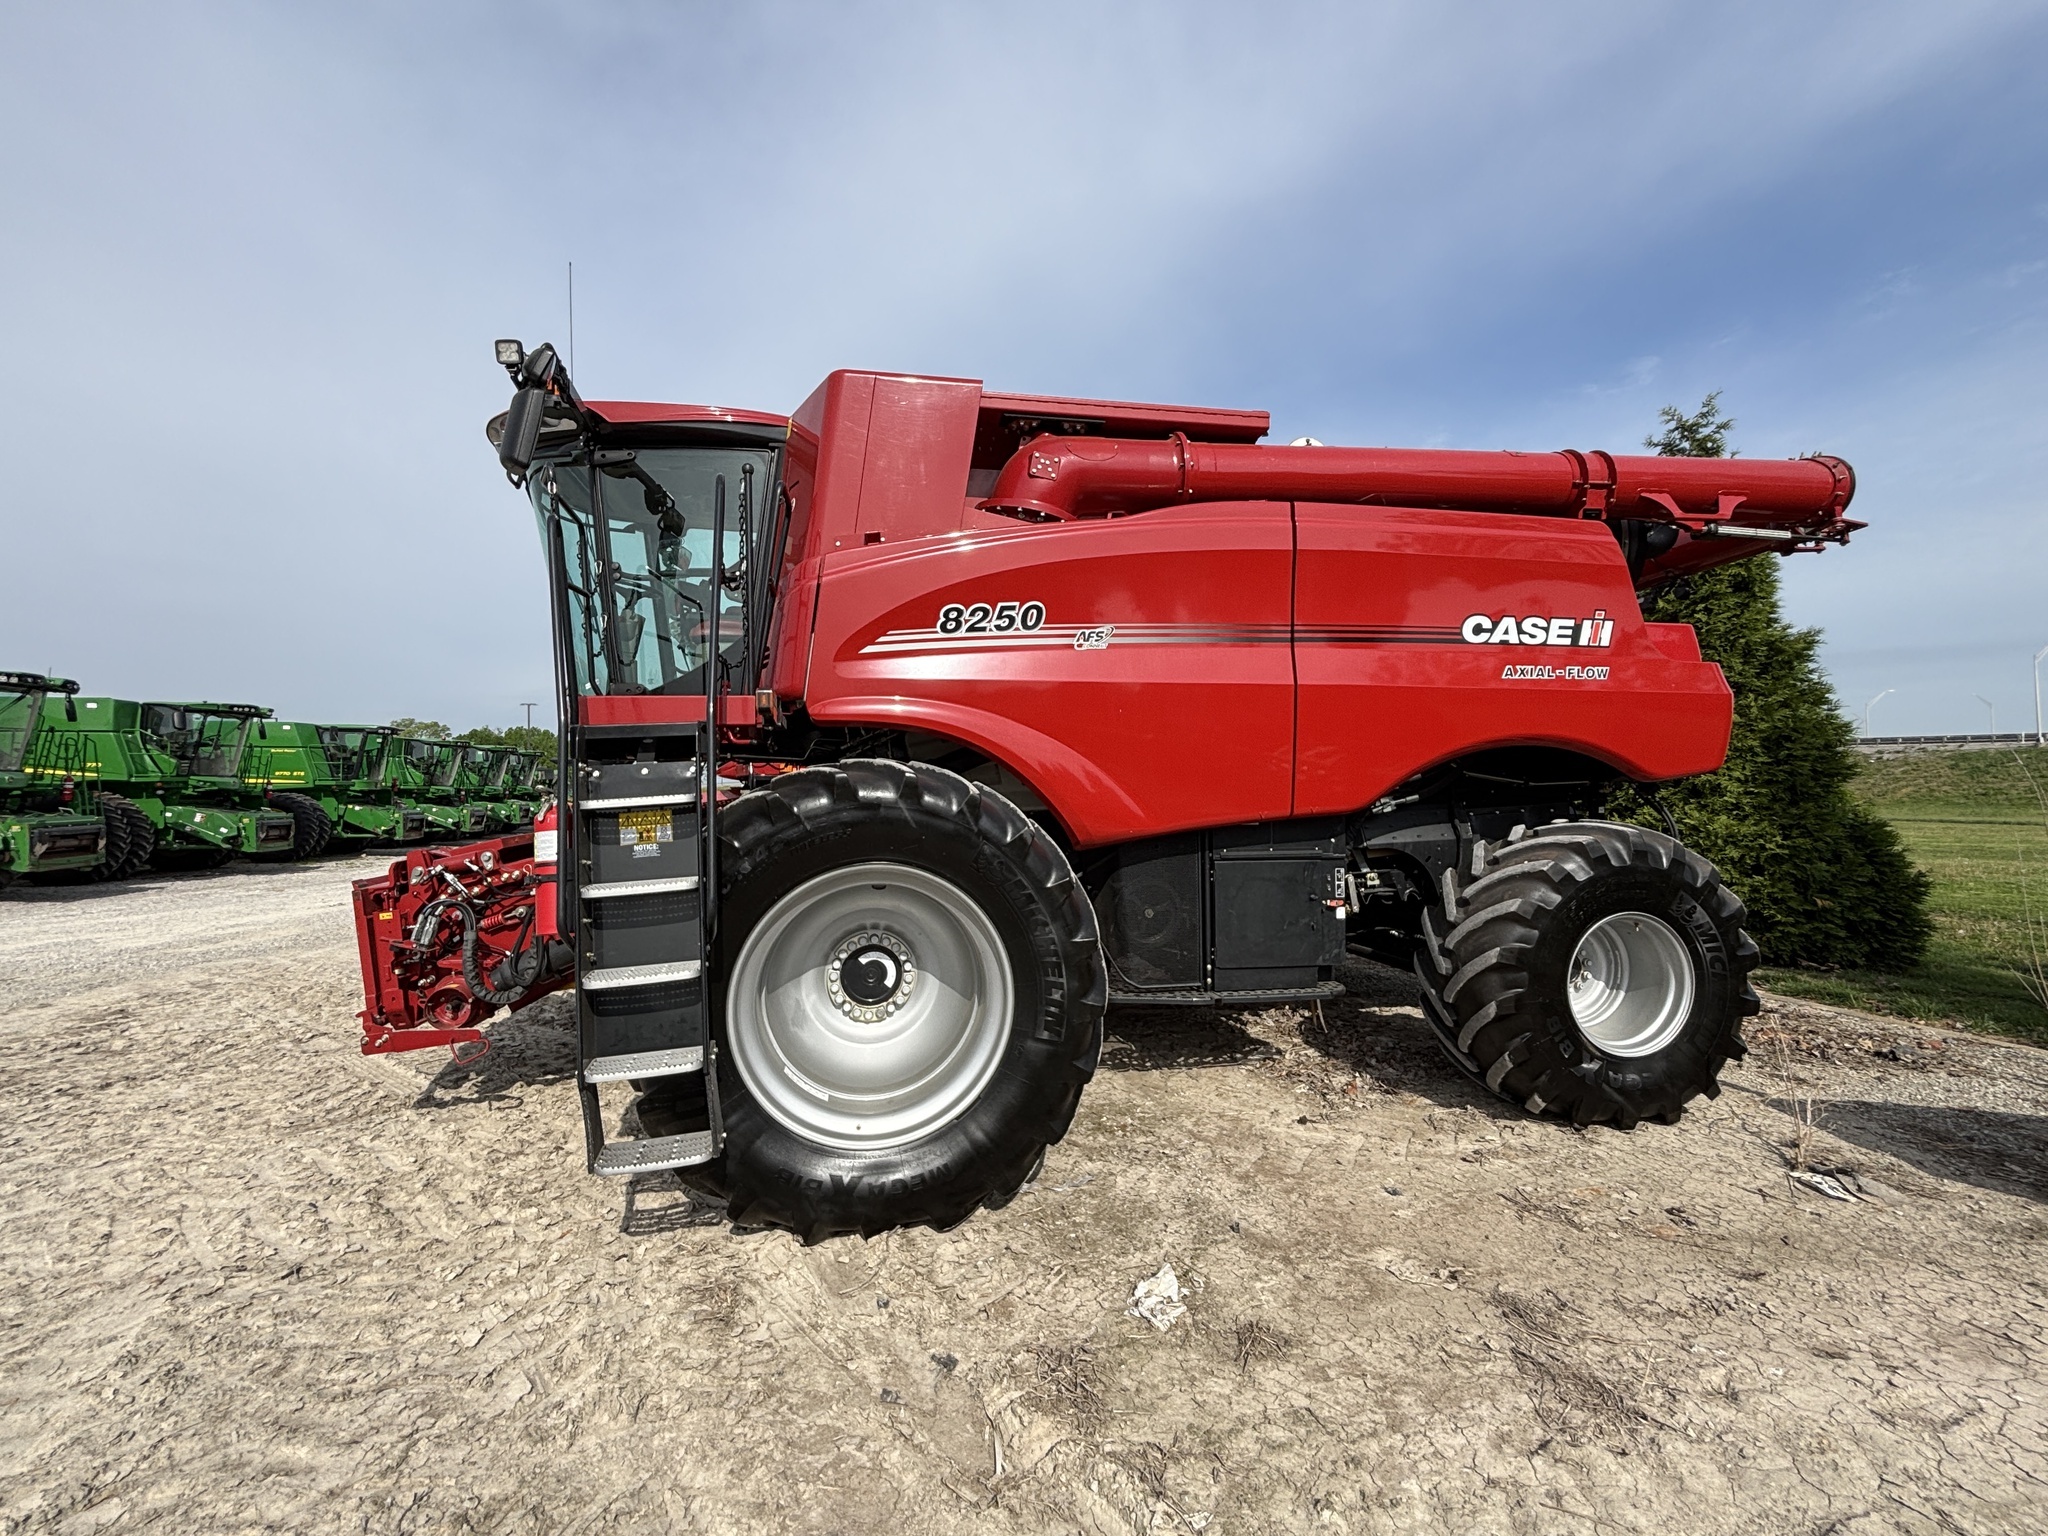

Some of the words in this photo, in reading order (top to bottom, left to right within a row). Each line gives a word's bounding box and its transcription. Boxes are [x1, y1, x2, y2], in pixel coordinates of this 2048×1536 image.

[937, 602, 1045, 635] 8250
[1461, 614, 1576, 646] CASE
[1075, 630, 1105, 643] AFS
[1501, 665, 1610, 680] AXIAL-FLOW
[1004, 877, 1066, 1040] MICHELIN
